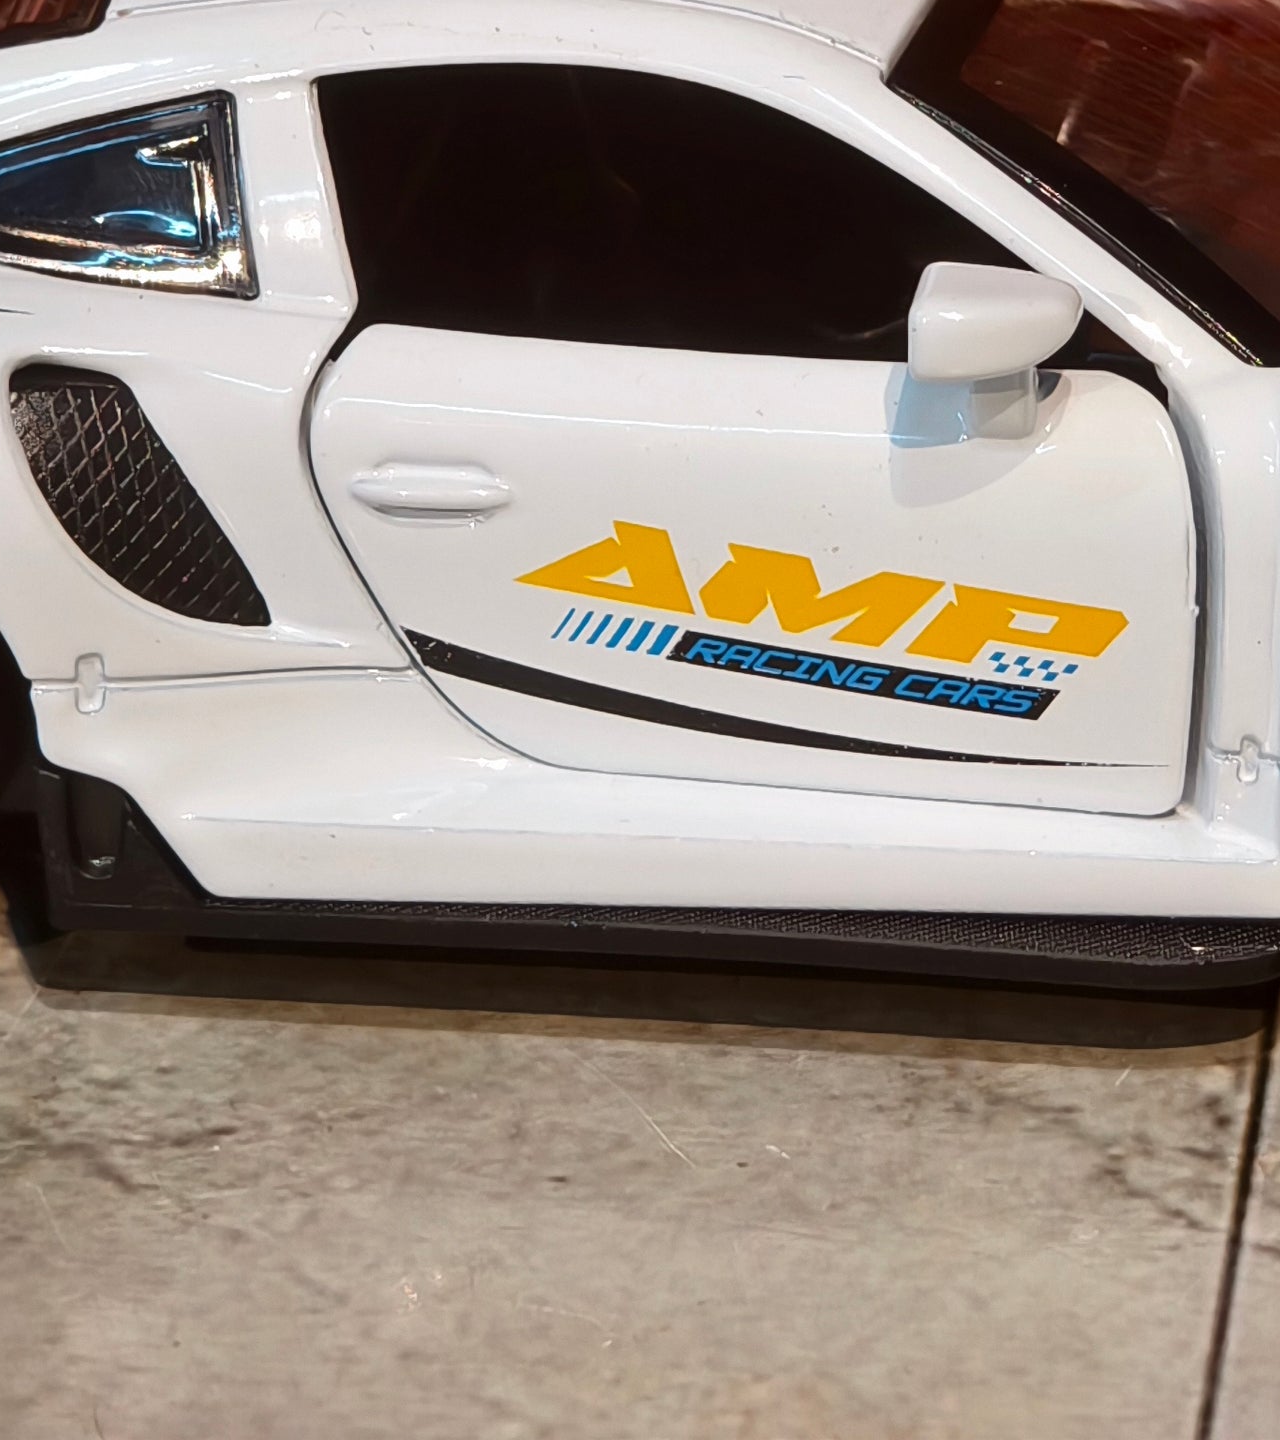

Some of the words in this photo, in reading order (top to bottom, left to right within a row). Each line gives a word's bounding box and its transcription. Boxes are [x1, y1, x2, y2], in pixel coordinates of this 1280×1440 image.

[513, 520, 1130, 664] AMP
[683, 631, 884, 691] RACING
[894, 674, 1039, 714] CARS
